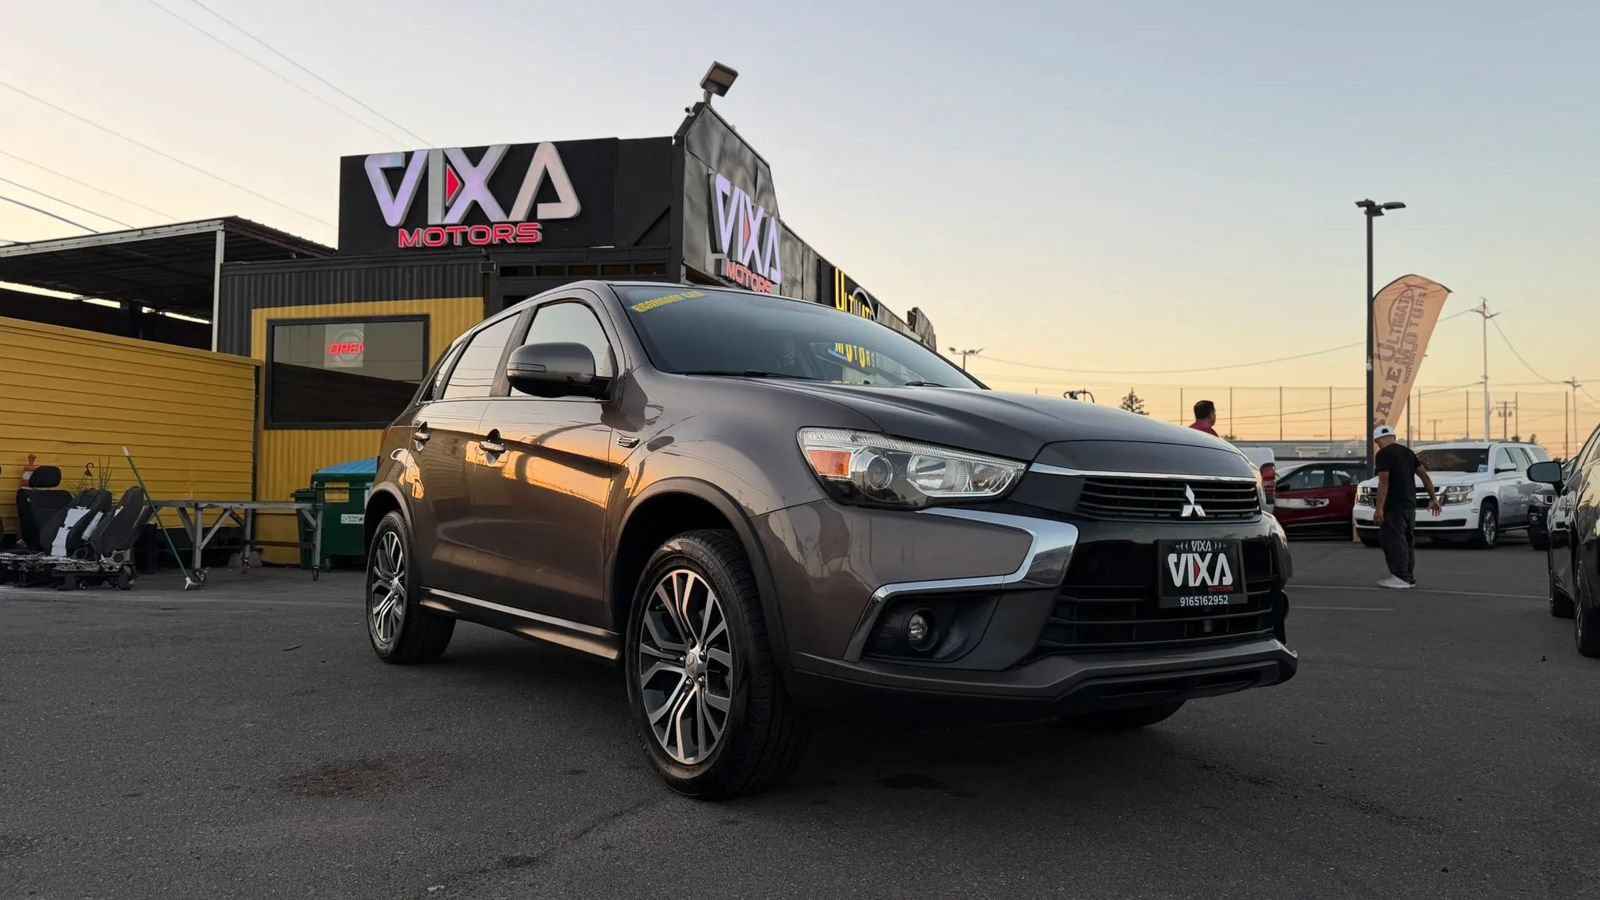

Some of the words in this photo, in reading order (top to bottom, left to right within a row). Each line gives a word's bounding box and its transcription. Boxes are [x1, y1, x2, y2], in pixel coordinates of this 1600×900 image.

[364, 142, 581, 227] VIXA
[398, 222, 542, 248] MOTORS
[715, 173, 781, 284] VIXA
[726, 258, 773, 293] MOTORS
[1191, 540, 1212, 552] VIXA
[1167, 552, 1233, 588] VIXA
[1180, 595, 1229, 607] 9165162952
